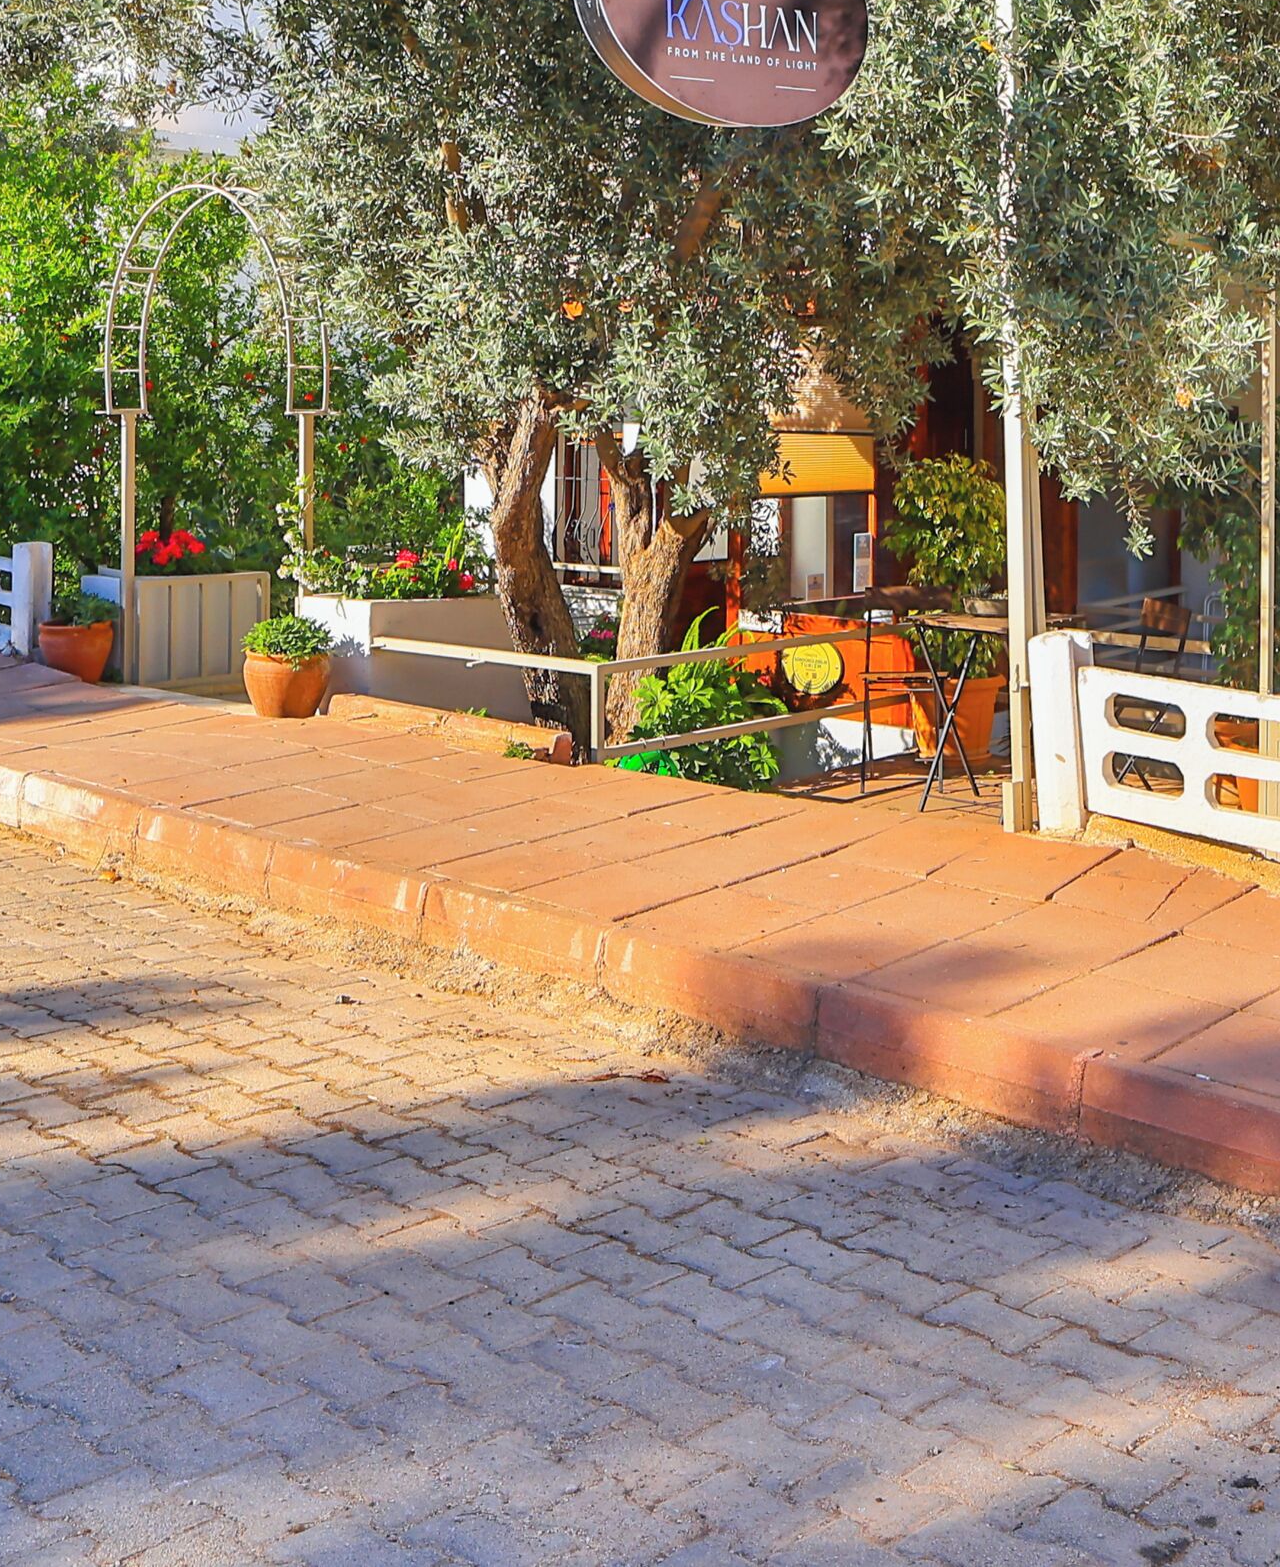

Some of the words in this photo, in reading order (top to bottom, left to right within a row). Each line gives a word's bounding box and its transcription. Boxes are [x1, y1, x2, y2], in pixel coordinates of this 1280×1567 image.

[667, 46, 699, 59] FROM
[705, 50, 726, 62] THE
[732, 53, 761, 66] LAND
[767, 57, 780, 67] OF
[786, 60, 818, 72] LIGHT
